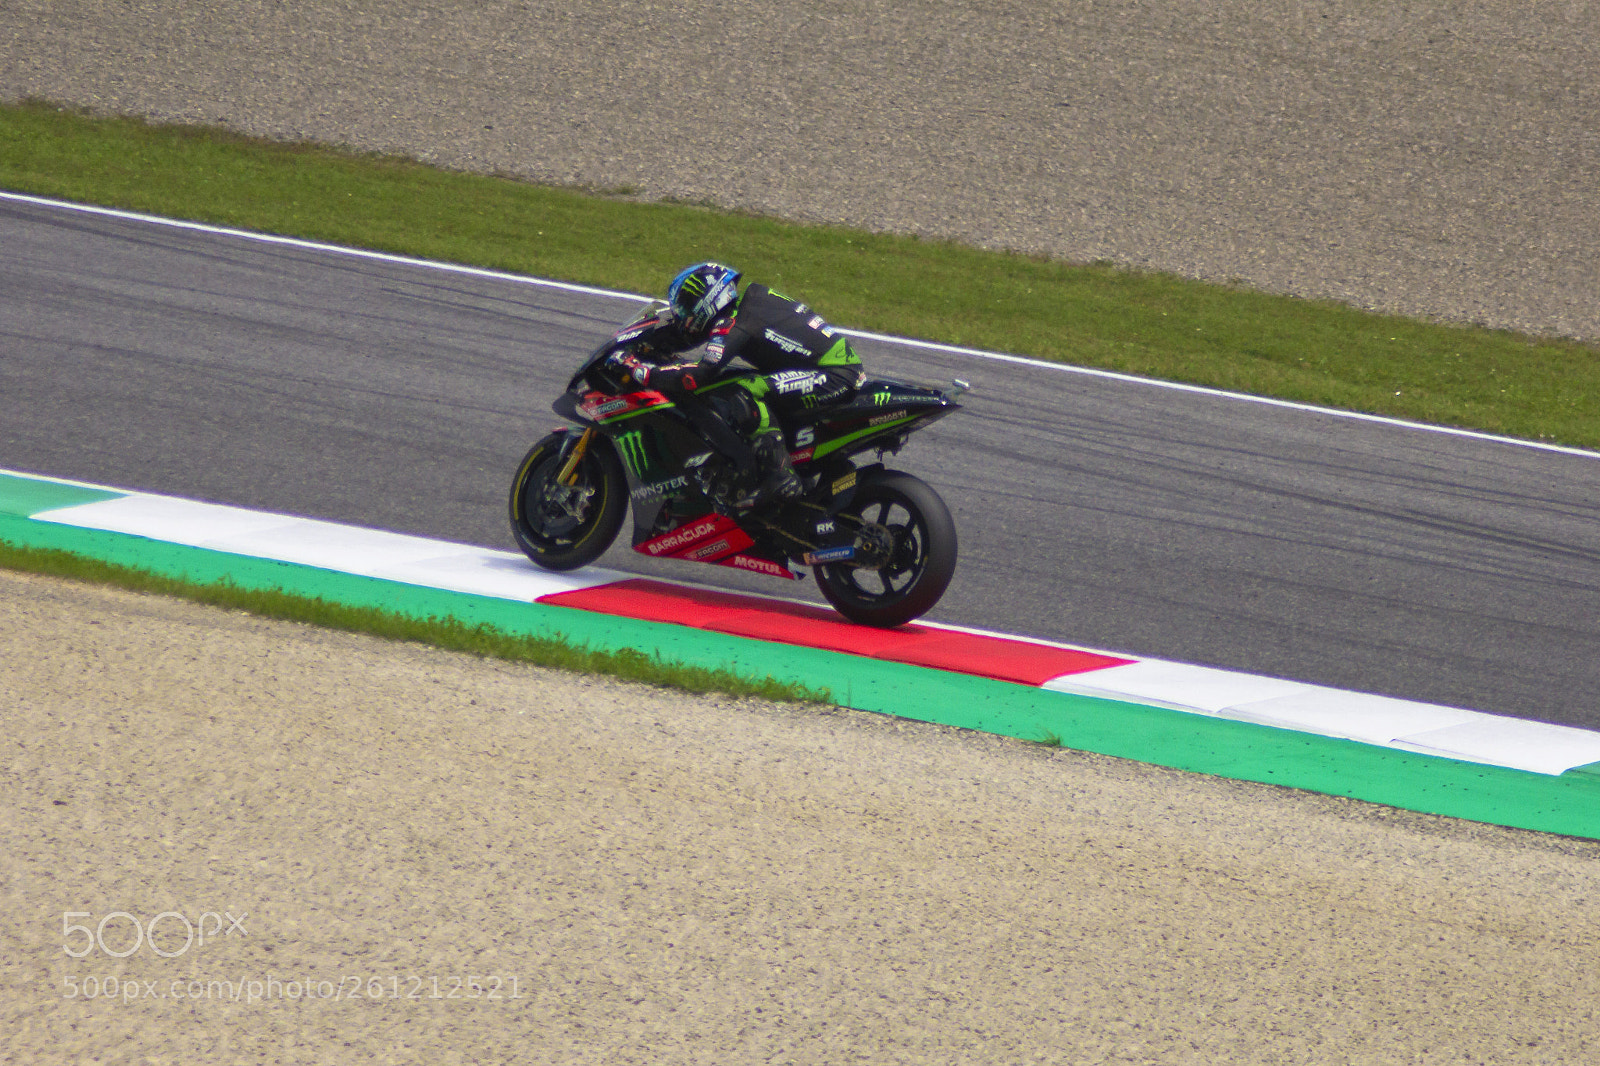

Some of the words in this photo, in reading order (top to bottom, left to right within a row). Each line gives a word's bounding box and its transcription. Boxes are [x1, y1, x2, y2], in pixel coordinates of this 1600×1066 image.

[630, 475, 688, 499] MONSTER
[647, 522, 716, 554] BARRACUDA
[816, 521, 836, 534] RK
[734, 556, 782, 575] MOTUL
